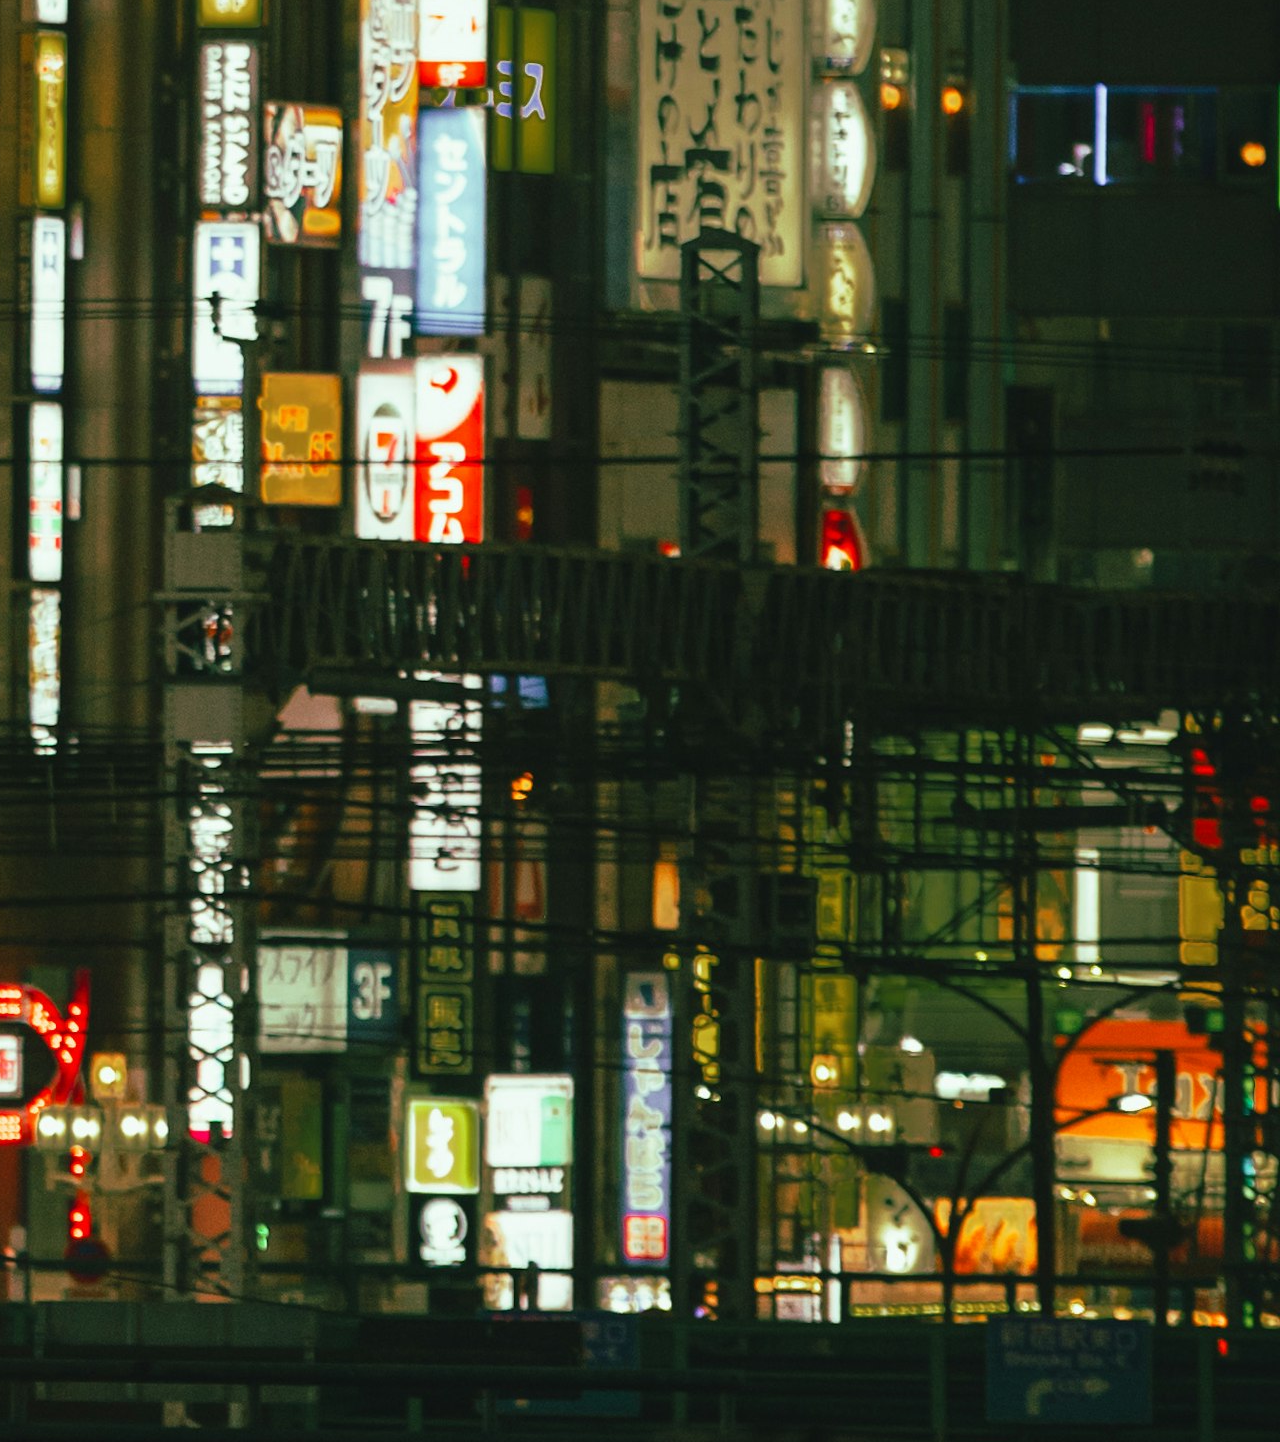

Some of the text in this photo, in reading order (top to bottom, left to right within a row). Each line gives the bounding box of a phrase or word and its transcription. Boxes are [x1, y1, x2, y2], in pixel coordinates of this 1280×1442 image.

[432, 132, 469, 309] セントラル
[362, 276, 413, 359] 7F
[429, 441, 467, 544] アコム
[352, 960, 393, 1021] 3F
